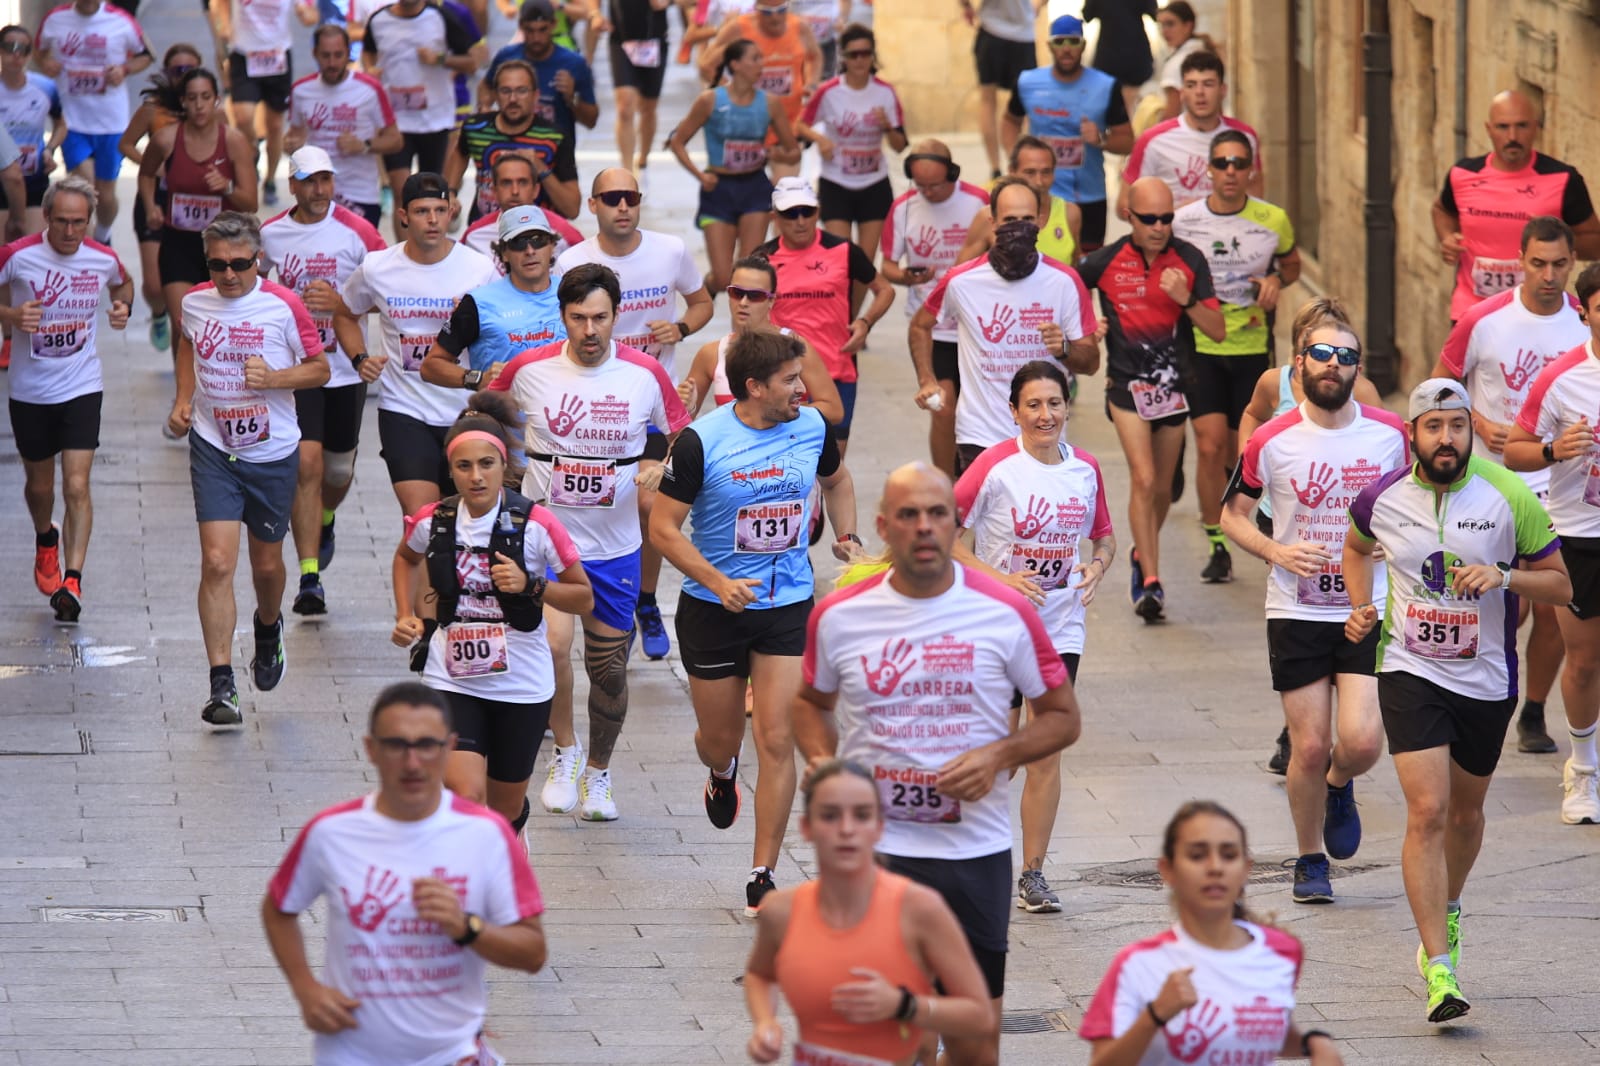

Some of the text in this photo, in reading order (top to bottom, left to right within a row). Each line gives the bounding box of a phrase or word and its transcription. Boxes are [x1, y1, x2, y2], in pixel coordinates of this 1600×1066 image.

[184, 205, 209, 220] 101
[1483, 272, 1516, 287] 213
[387, 296, 455, 308] FISIOCENTR
[388, 308, 453, 320] SALAMAN
[44, 328, 77, 348] 380
[1006, 334, 1043, 345] CARRE
[1143, 389, 1172, 407] 369
[213, 404, 269, 419] bedunia
[225, 417, 259, 437] 166
[575, 427, 629, 441] CARRERA
[564, 474, 603, 494] 505
[752, 517, 789, 538] 131
[1313, 531, 1333, 542] MAYOR
[1335, 532, 1343, 542] DE
[1013, 544, 1073, 559] bedunia
[1319, 574, 1346, 593] 85
[1407, 604, 1478, 625] bedunia
[1417, 622, 1460, 645] 351
[453, 640, 491, 662] 300
[901, 681, 974, 697] CARRERA
[914, 726, 924, 739] DE
[874, 765, 938, 785] bedun
[892, 783, 942, 809] 235
